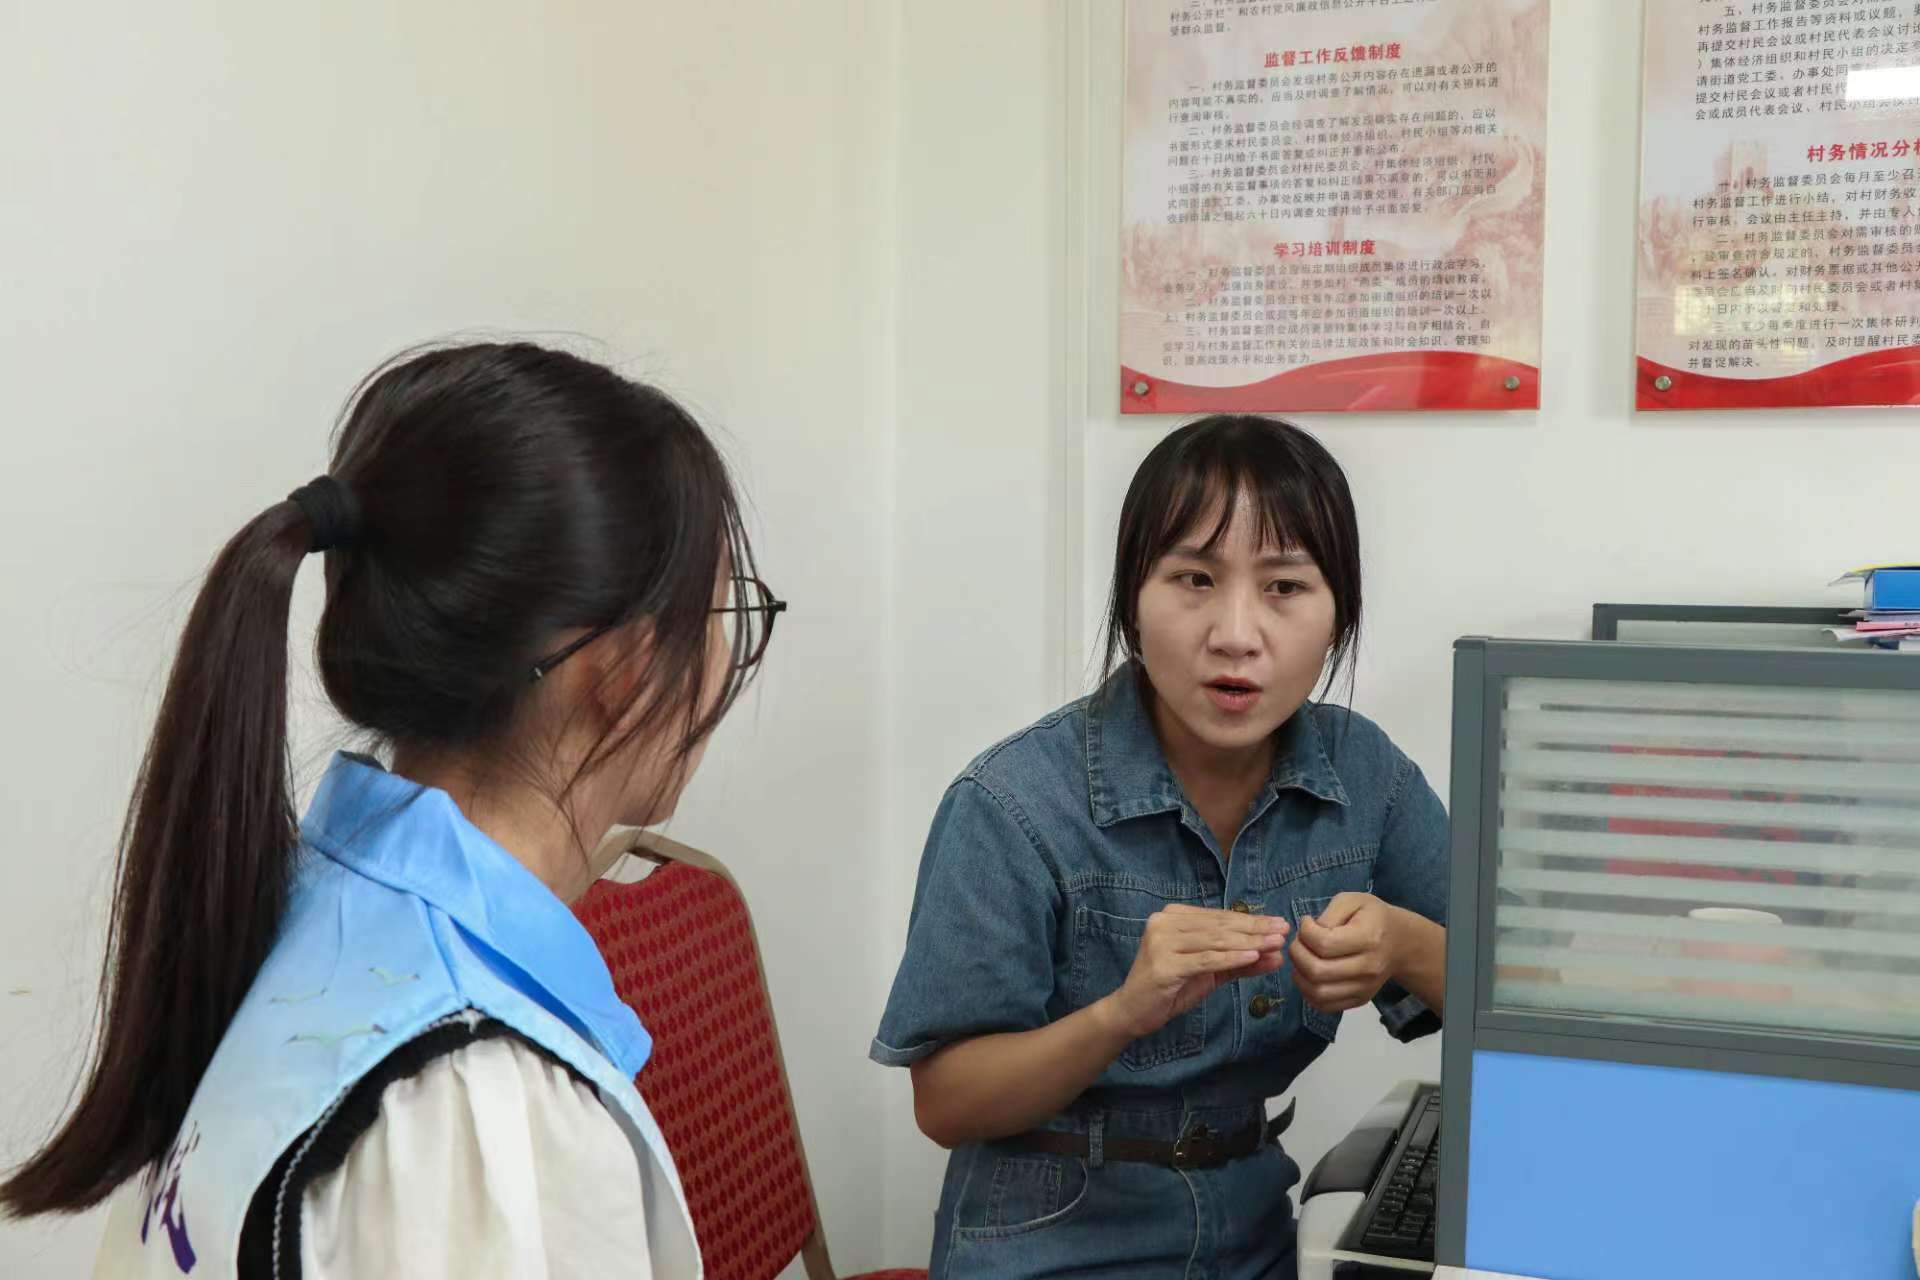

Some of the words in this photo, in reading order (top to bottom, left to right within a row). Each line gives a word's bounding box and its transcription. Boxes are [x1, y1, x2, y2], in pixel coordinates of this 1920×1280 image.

[1724, 0, 1893, 17] 五、村务监督委员
[1265, 42, 1403, 69] 监督工作反馈制度
[1273, 239, 1376, 258] 学习培训制度
[1688, 357, 1762, 369] 并督促解决。
